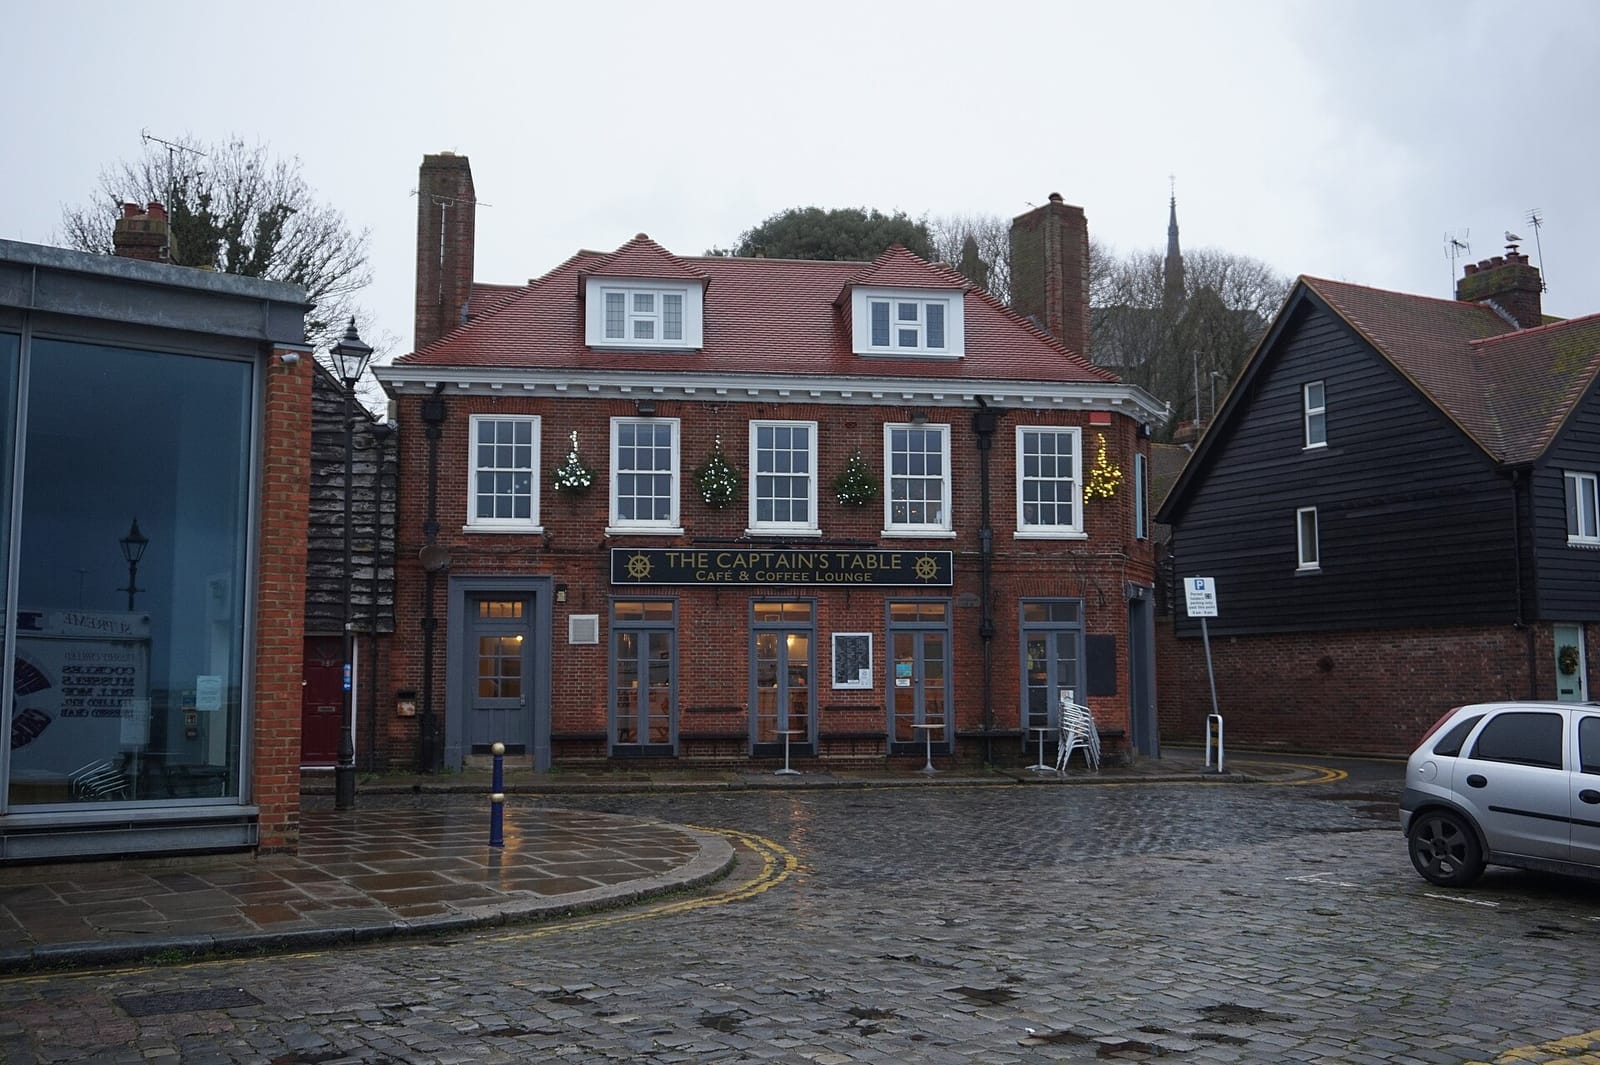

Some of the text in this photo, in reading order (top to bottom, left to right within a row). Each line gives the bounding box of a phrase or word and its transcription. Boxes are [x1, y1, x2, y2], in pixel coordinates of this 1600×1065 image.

[665, 552, 902, 569] THE CAPTAIN'S TABLE
[738, 570, 749, 581] &
[755, 570, 809, 581] COFFEE
[815, 571, 873, 582] LOUNGE
[1196, 580, 1203, 590] P
